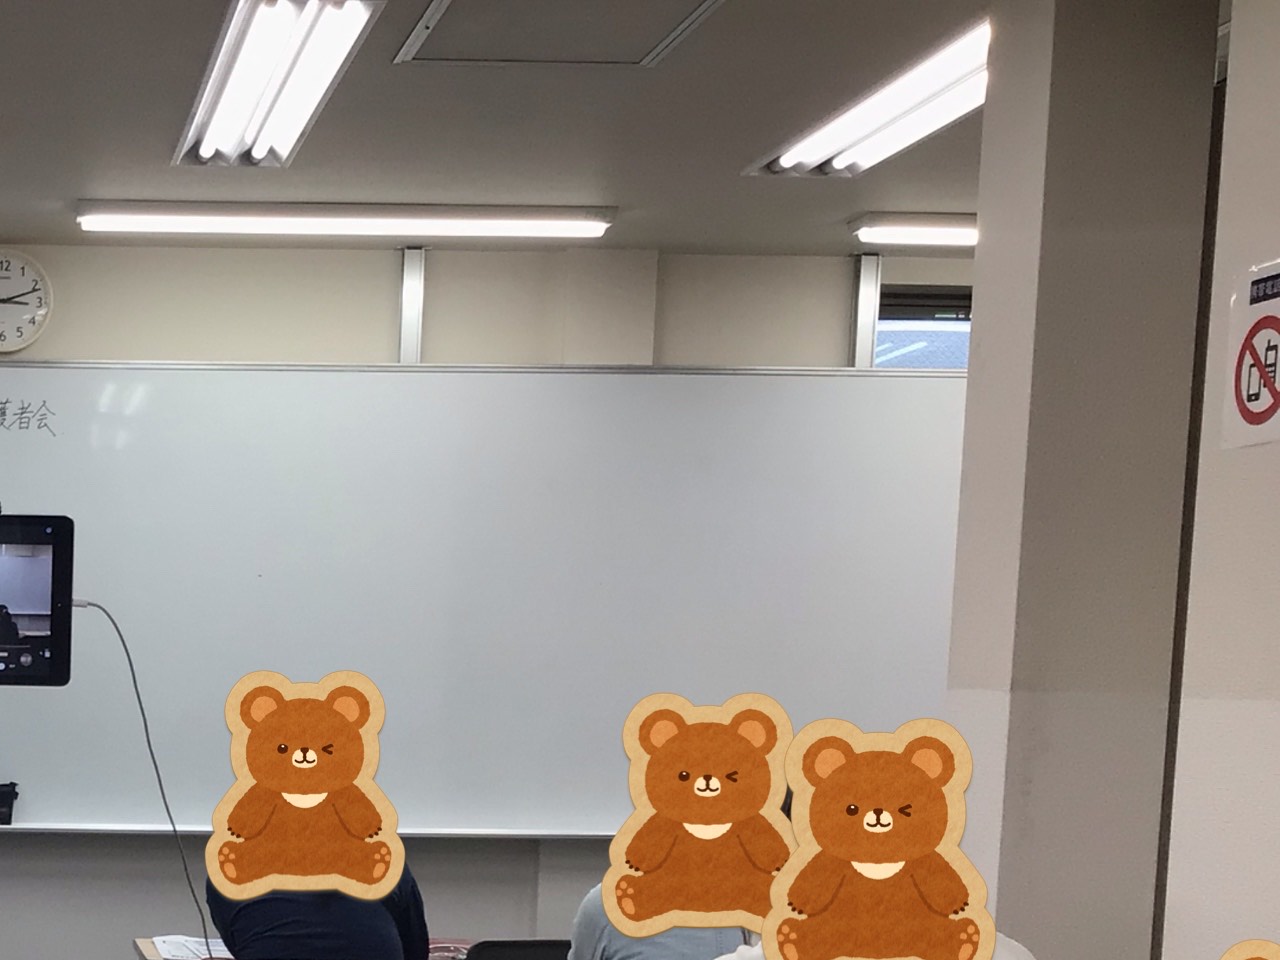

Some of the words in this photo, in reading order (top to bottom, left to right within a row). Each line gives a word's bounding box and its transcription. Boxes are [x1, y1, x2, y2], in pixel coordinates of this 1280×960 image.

[0, 260, 11, 272] 12
[20, 266, 25, 277] 1
[32, 279, 39, 291] 2
[36, 297, 43, 308] 3
[28, 316, 36, 326] 4
[0, 331, 7, 342] 6
[16, 327, 23, 338] 5
